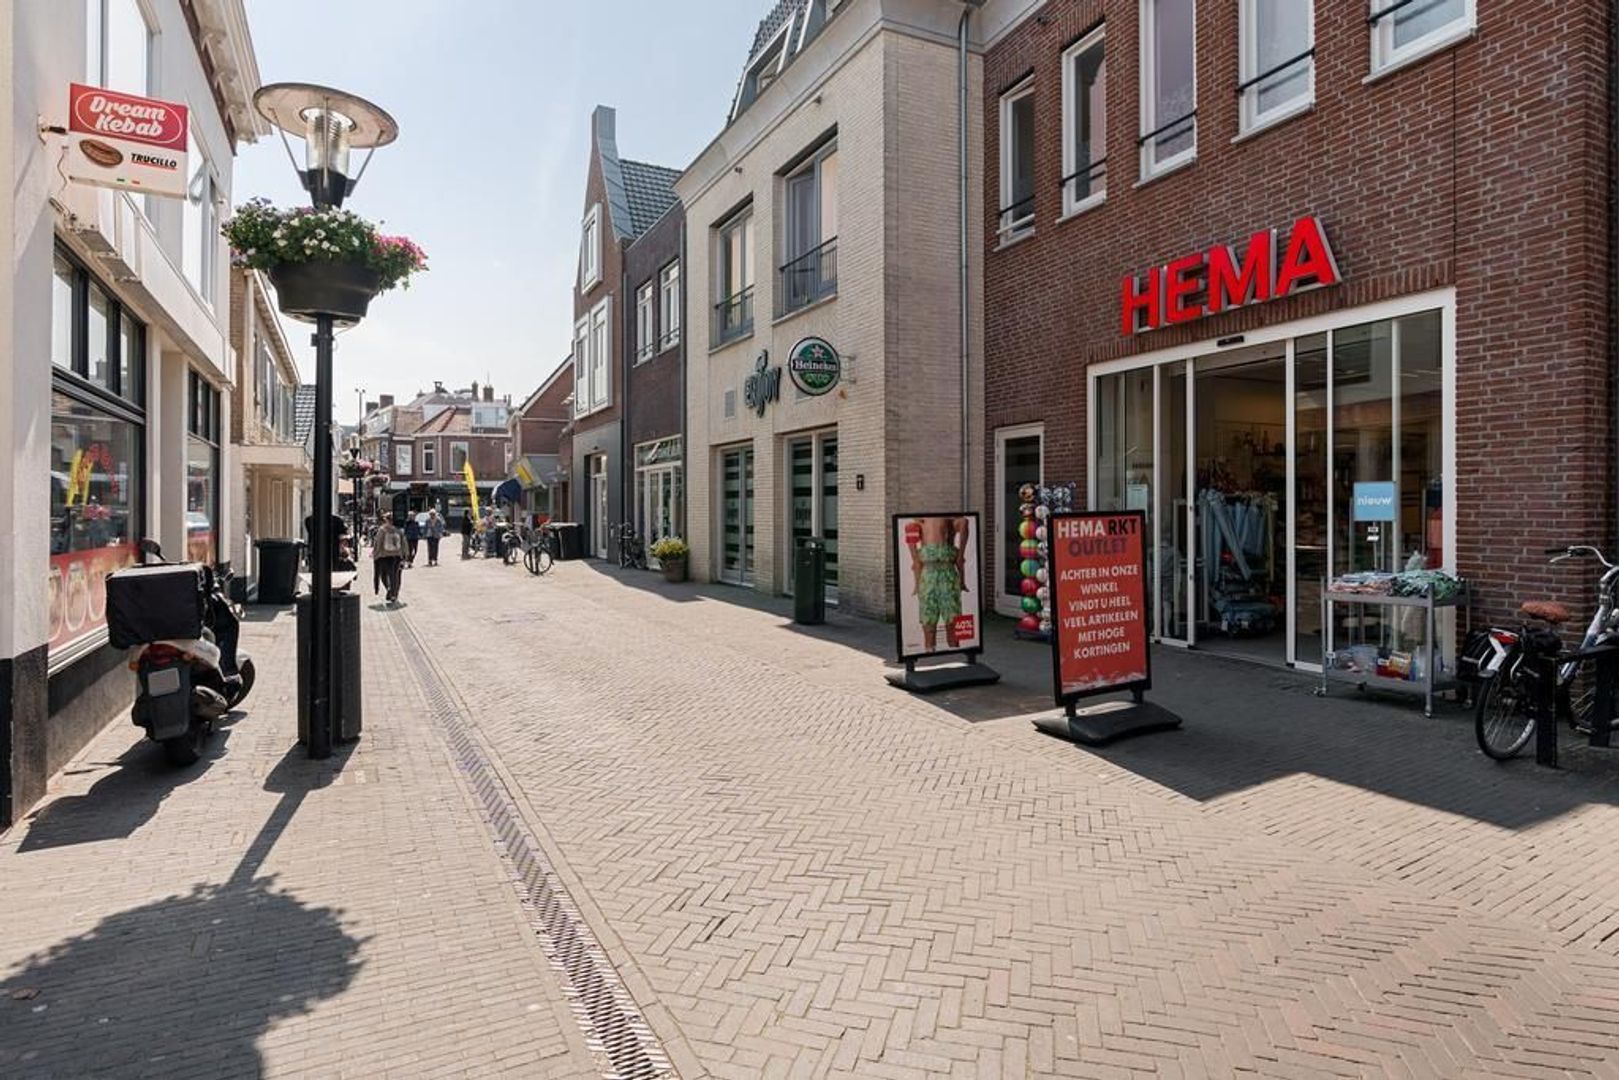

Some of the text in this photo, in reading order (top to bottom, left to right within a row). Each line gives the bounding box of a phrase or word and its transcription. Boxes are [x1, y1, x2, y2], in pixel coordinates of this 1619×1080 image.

[90, 97, 166, 121] Dream
[95, 114, 162, 136] Kebab
[131, 153, 176, 167] TRUCILLO
[1121, 215, 1341, 336] HEMA
[1358, 495, 1392, 506] nieuw
[1069, 538, 1126, 556] OUTLET
[1060, 564, 1138, 581] ACHTER IN ONZE
[1080, 582, 1118, 596] WINKEL
[1068, 596, 1131, 612] VINDT U HEEL
[1063, 609, 1138, 629] VEEL ARTIKELEN
[1078, 626, 1125, 643] MET HOGE
[1074, 642, 1130, 659] KORTINGEN
